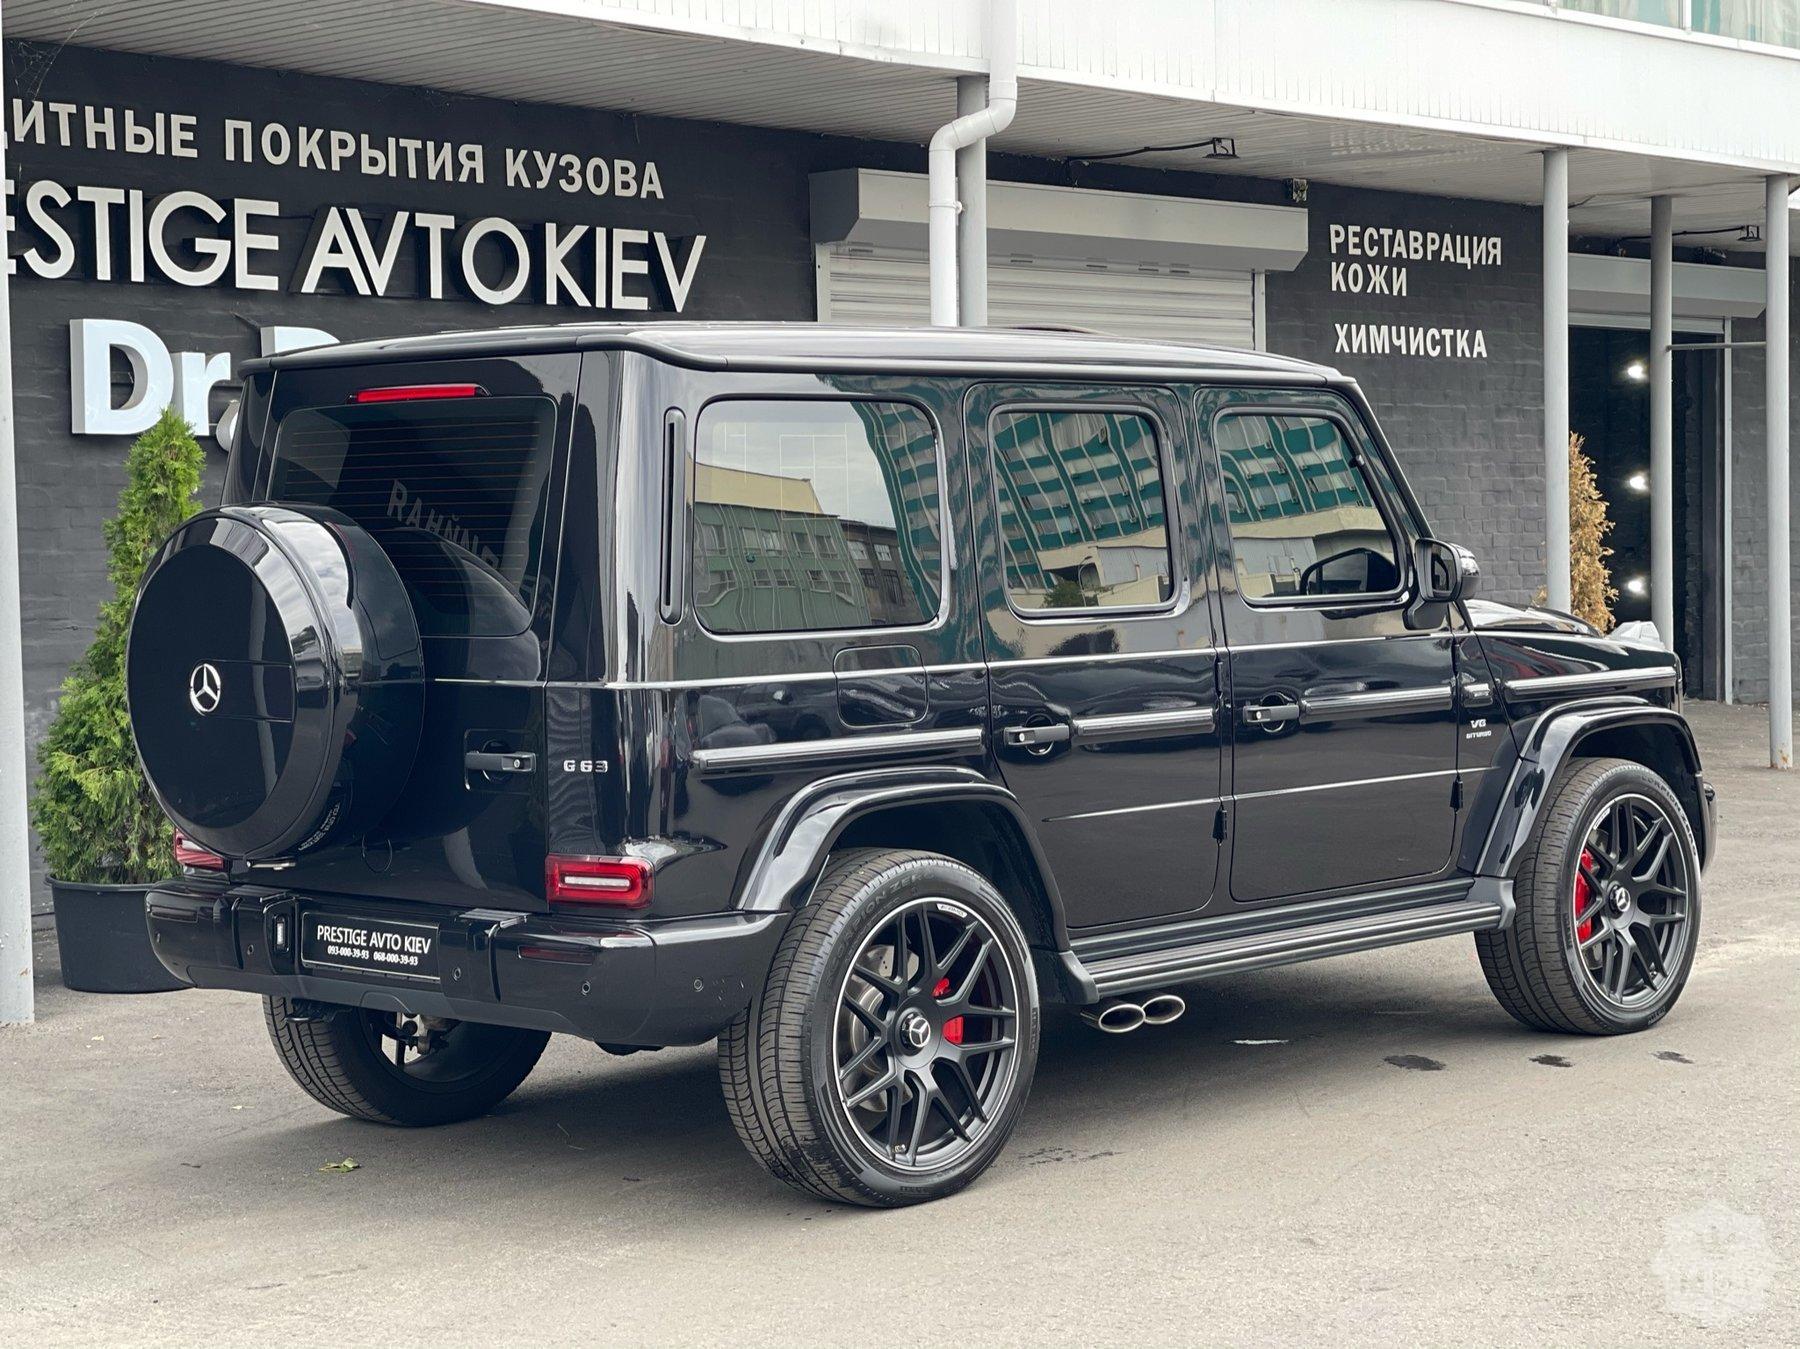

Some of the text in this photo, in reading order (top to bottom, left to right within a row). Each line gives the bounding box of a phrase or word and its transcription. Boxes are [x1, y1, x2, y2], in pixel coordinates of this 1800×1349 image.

[4, 98, 665, 200] ИТНЫЕ ПОКРЫТИЯ КУЗОВА
[5, 180, 280, 291] STIGE
[1329, 224, 1502, 269] РЕСТАВРАЦИЯ
[1331, 262, 1407, 296] КОЖИ
[1334, 323, 1488, 358] ХИМЧИСТКА
[317, 924, 432, 955] PRESTIGE AVTO KIEV
[327, 944, 419, 966] 093-000-39-93 068-000-39-93
